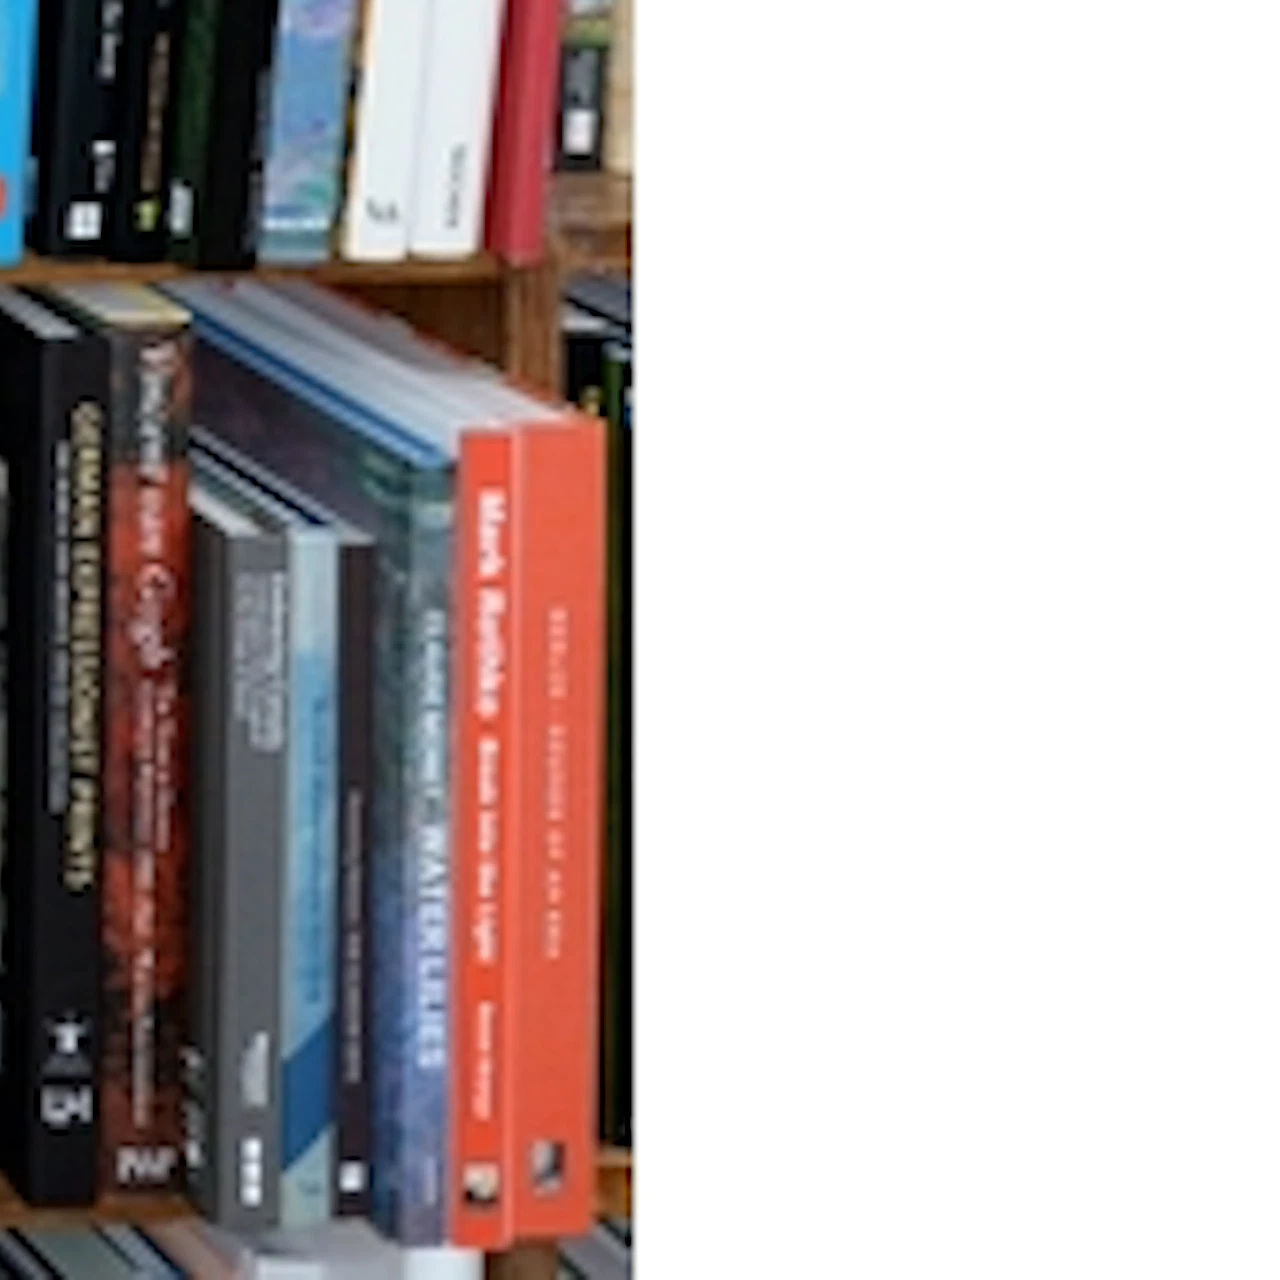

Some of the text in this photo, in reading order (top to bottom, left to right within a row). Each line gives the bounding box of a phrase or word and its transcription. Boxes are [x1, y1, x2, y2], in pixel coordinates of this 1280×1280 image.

[70, 403, 103, 538] GERMAN
[137, 346, 178, 479] Vincent
[137, 484, 170, 556] van
[68, 543, 102, 774] EXPRESSIONIST
[124, 564, 175, 673] Gogh
[472, 488, 508, 964] Mark Rothko Break into the Light
[63, 778, 98, 892] PRINTS
[416, 824, 447, 949] WATER
[416, 952, 446, 1070] LILIES
